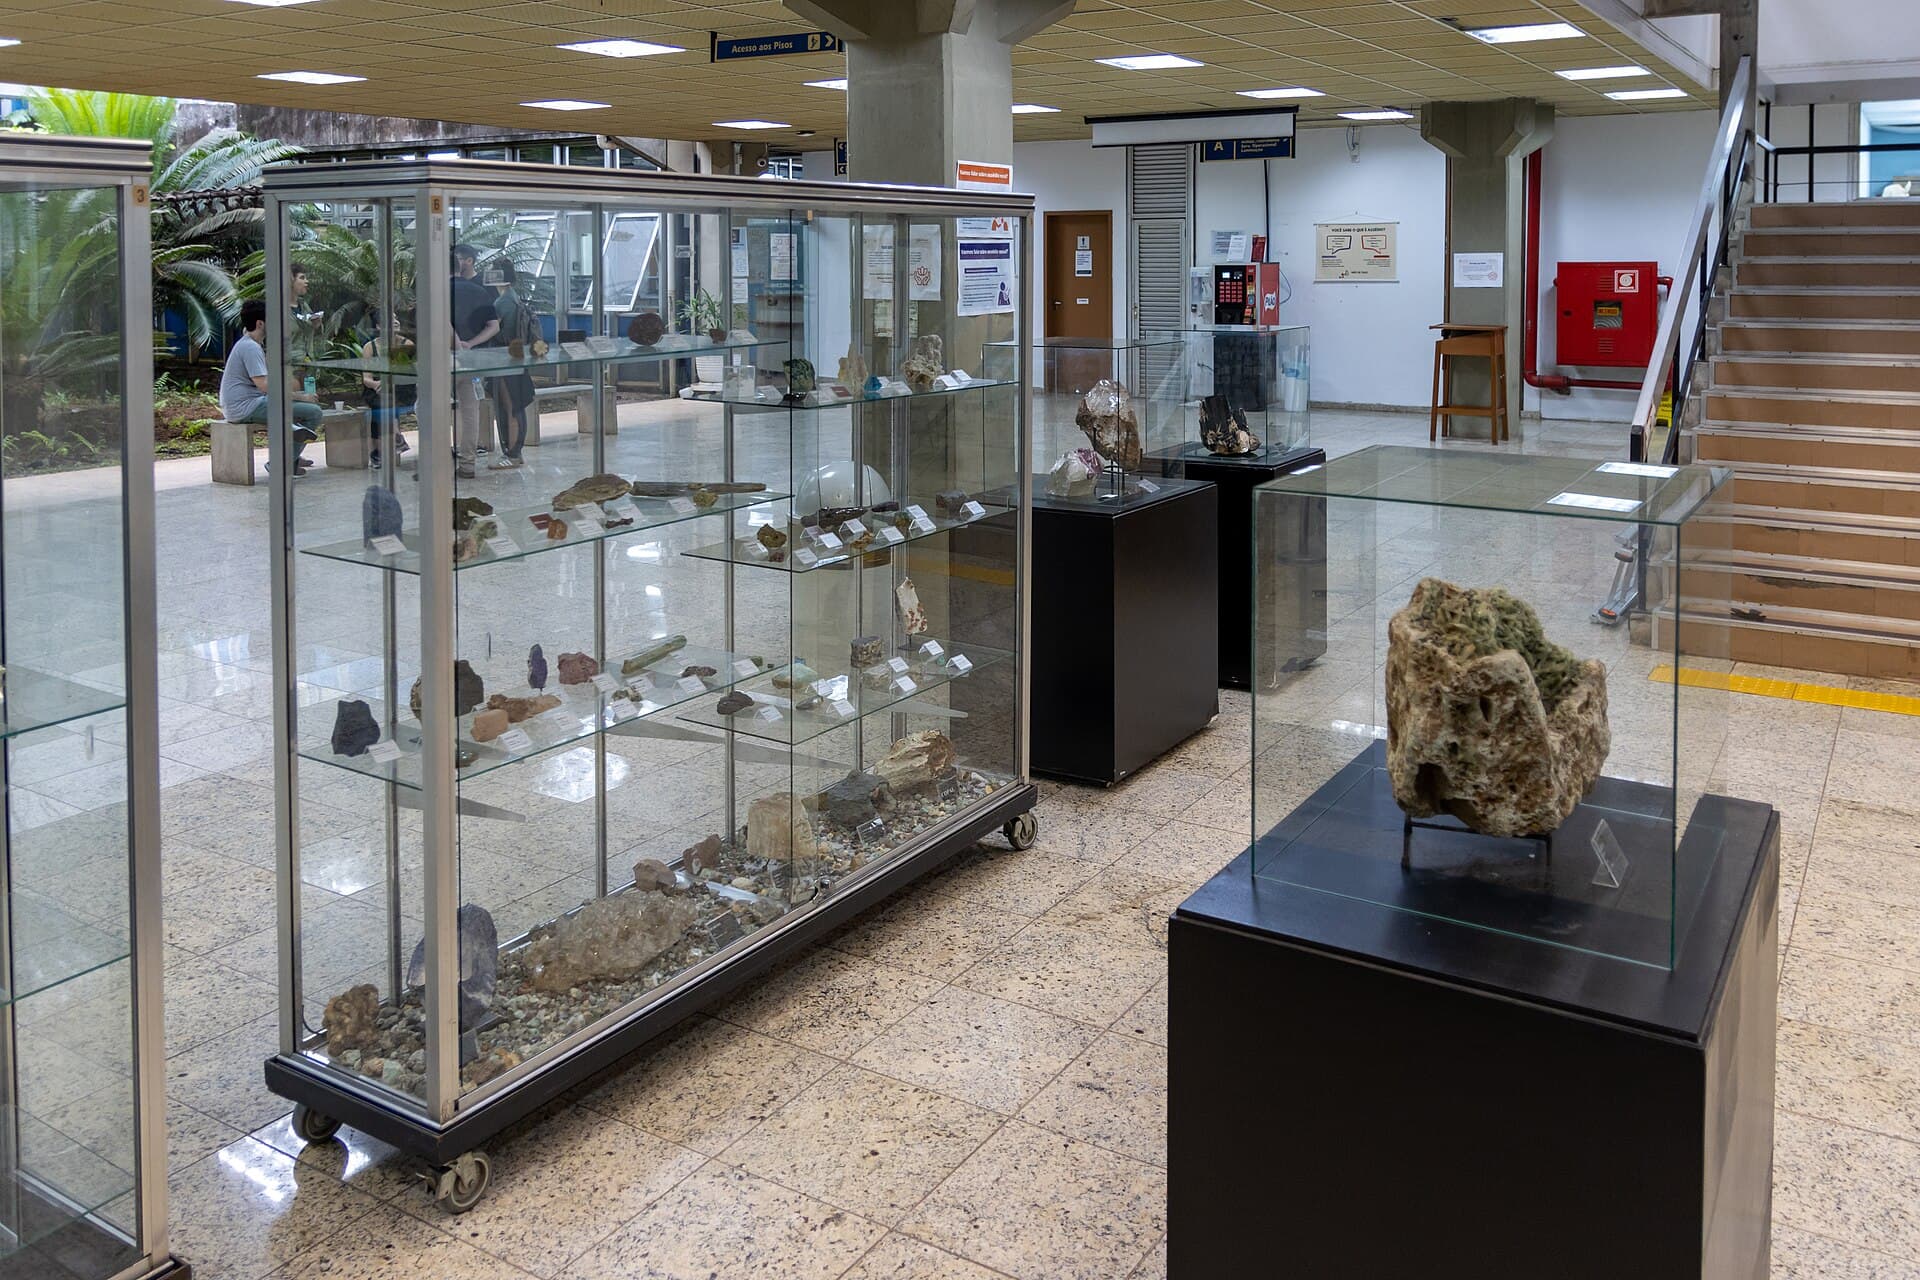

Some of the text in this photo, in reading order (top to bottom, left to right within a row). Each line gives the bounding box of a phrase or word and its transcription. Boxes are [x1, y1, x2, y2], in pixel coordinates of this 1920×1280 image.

[732, 45, 757, 53] Acesso
[773, 41, 793, 50] Pisos
[1214, 141, 1224, 151] A
[137, 188, 145, 203] 3
[434, 198, 440, 211] 6
